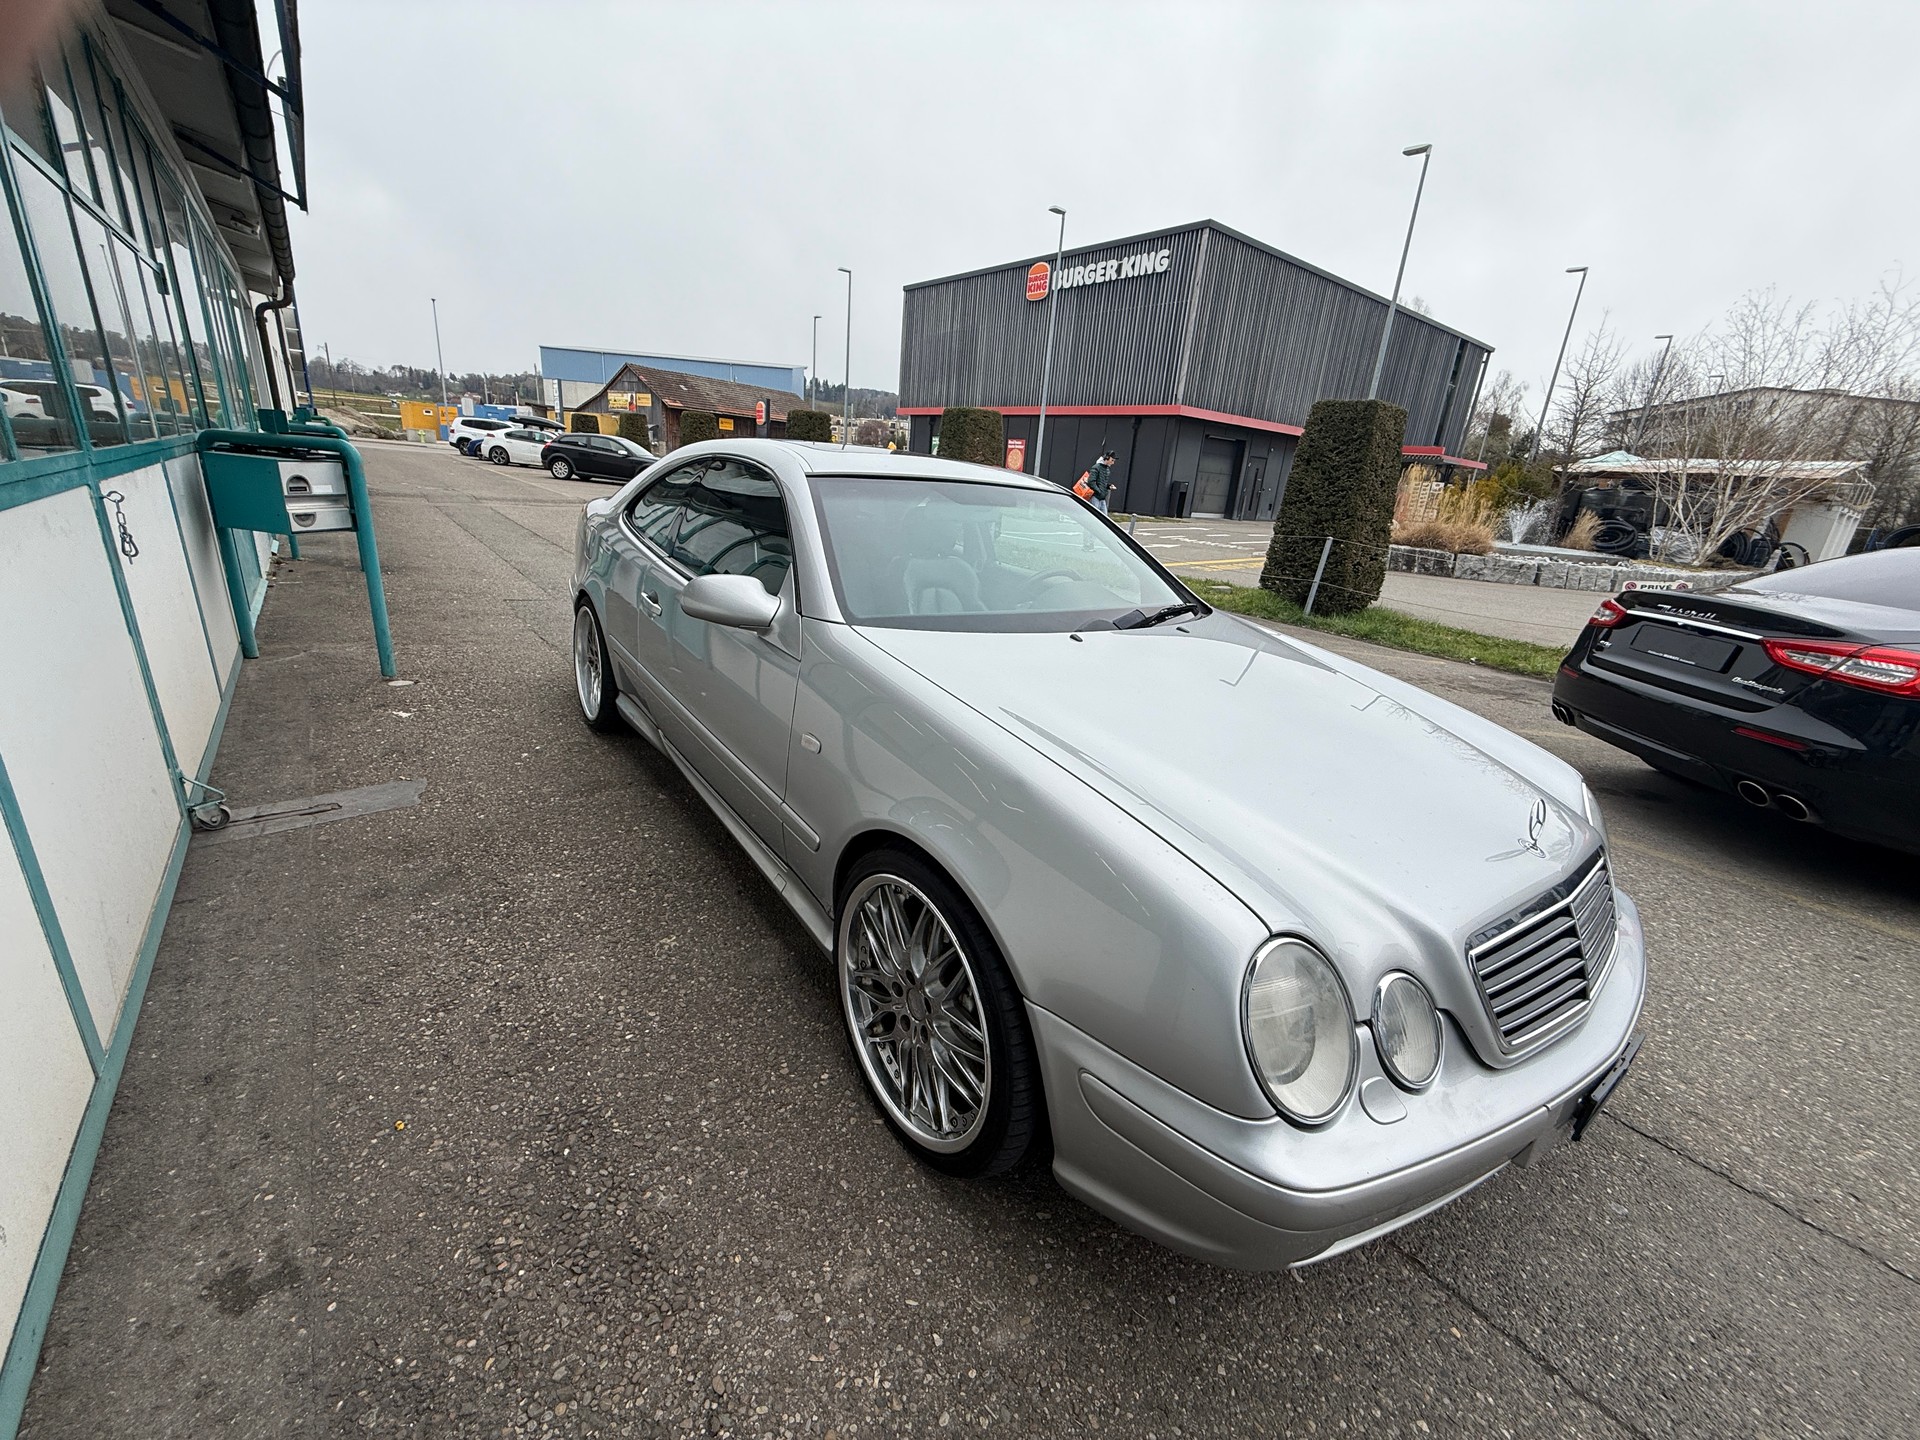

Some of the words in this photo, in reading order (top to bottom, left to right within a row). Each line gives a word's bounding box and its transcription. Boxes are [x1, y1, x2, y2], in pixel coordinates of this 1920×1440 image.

[1028, 273, 1049, 283] BURGER
[1052, 259, 1117, 291] BURGER
[1120, 249, 1171, 278] KING
[1027, 280, 1048, 294] KING
[1657, 603, 1720, 623] Maserati
